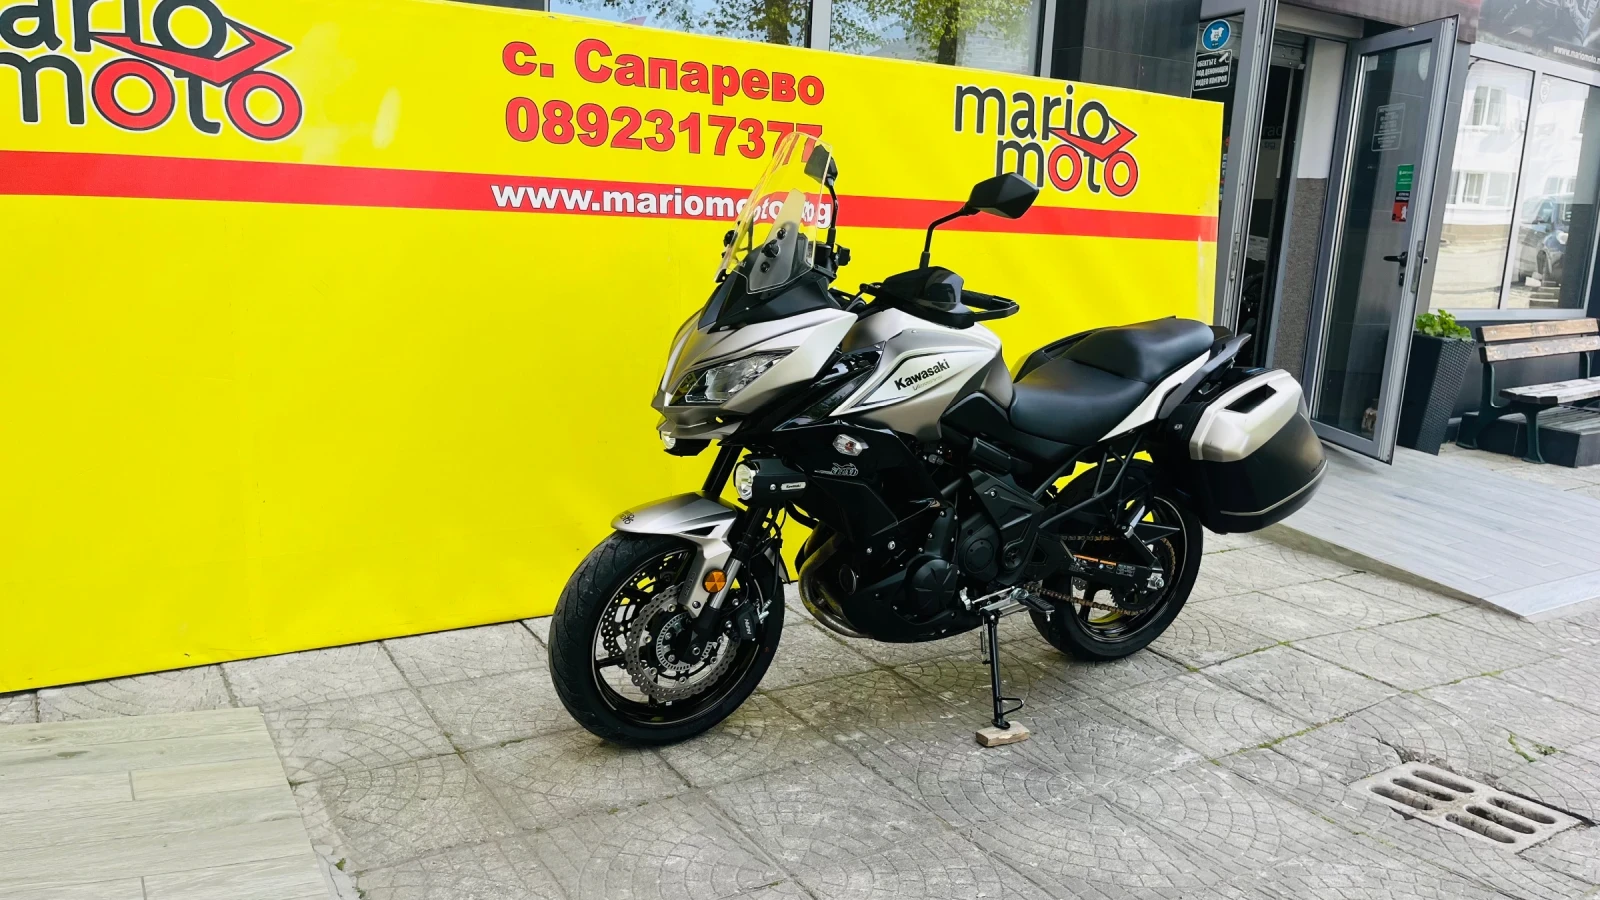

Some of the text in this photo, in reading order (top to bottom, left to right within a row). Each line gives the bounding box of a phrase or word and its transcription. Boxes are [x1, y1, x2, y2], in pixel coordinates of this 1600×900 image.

[0, 0, 228, 59] ario
[502, 38, 825, 106] с. Сапарево
[505, 97, 823, 165] 0892317377
[954, 84, 1110, 144] mario
[996, 139, 1139, 197] moto
[490, 183, 832, 229] www.mariomotobg
[894, 358, 950, 391] Kawasaki
